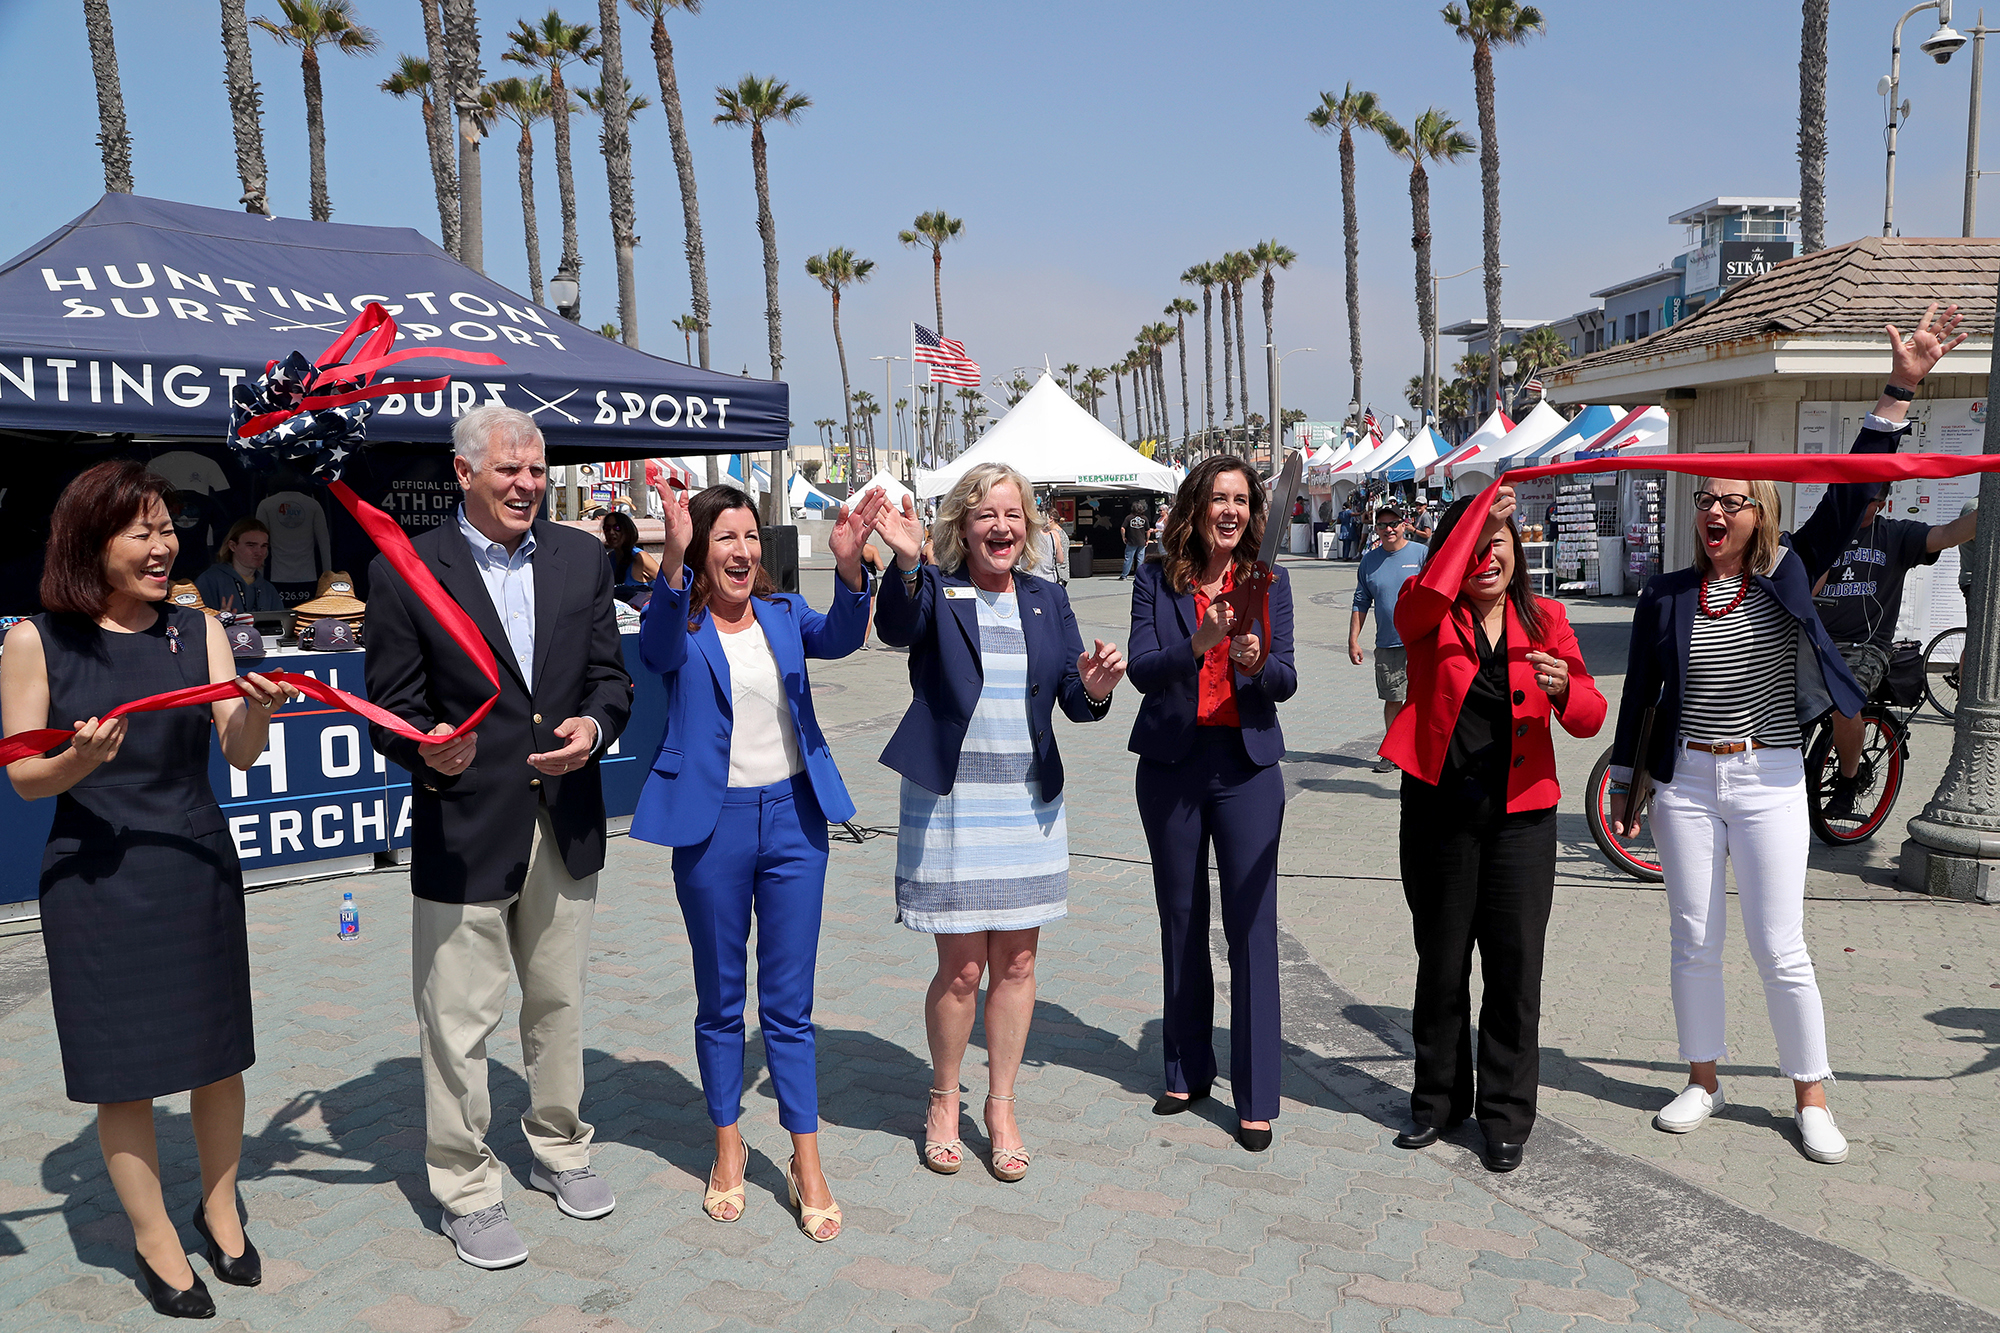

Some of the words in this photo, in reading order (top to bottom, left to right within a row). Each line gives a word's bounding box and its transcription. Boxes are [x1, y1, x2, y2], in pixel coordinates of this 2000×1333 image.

[1726, 261, 1781, 275] STRAN
[41, 262, 549, 330] HUNTINGTON
[62, 297, 256, 326] SURF
[357, 321, 567, 352] PORT
[0, 357, 247, 408] NTINGT
[593, 391, 731, 430] SPORT
[392, 480, 441, 490] OFFICIAL
[443, 481, 460, 491] CIT
[381, 492, 426, 511] 4TH
[433, 495, 454, 509] OF
[342, 912, 354, 922] FIJI
